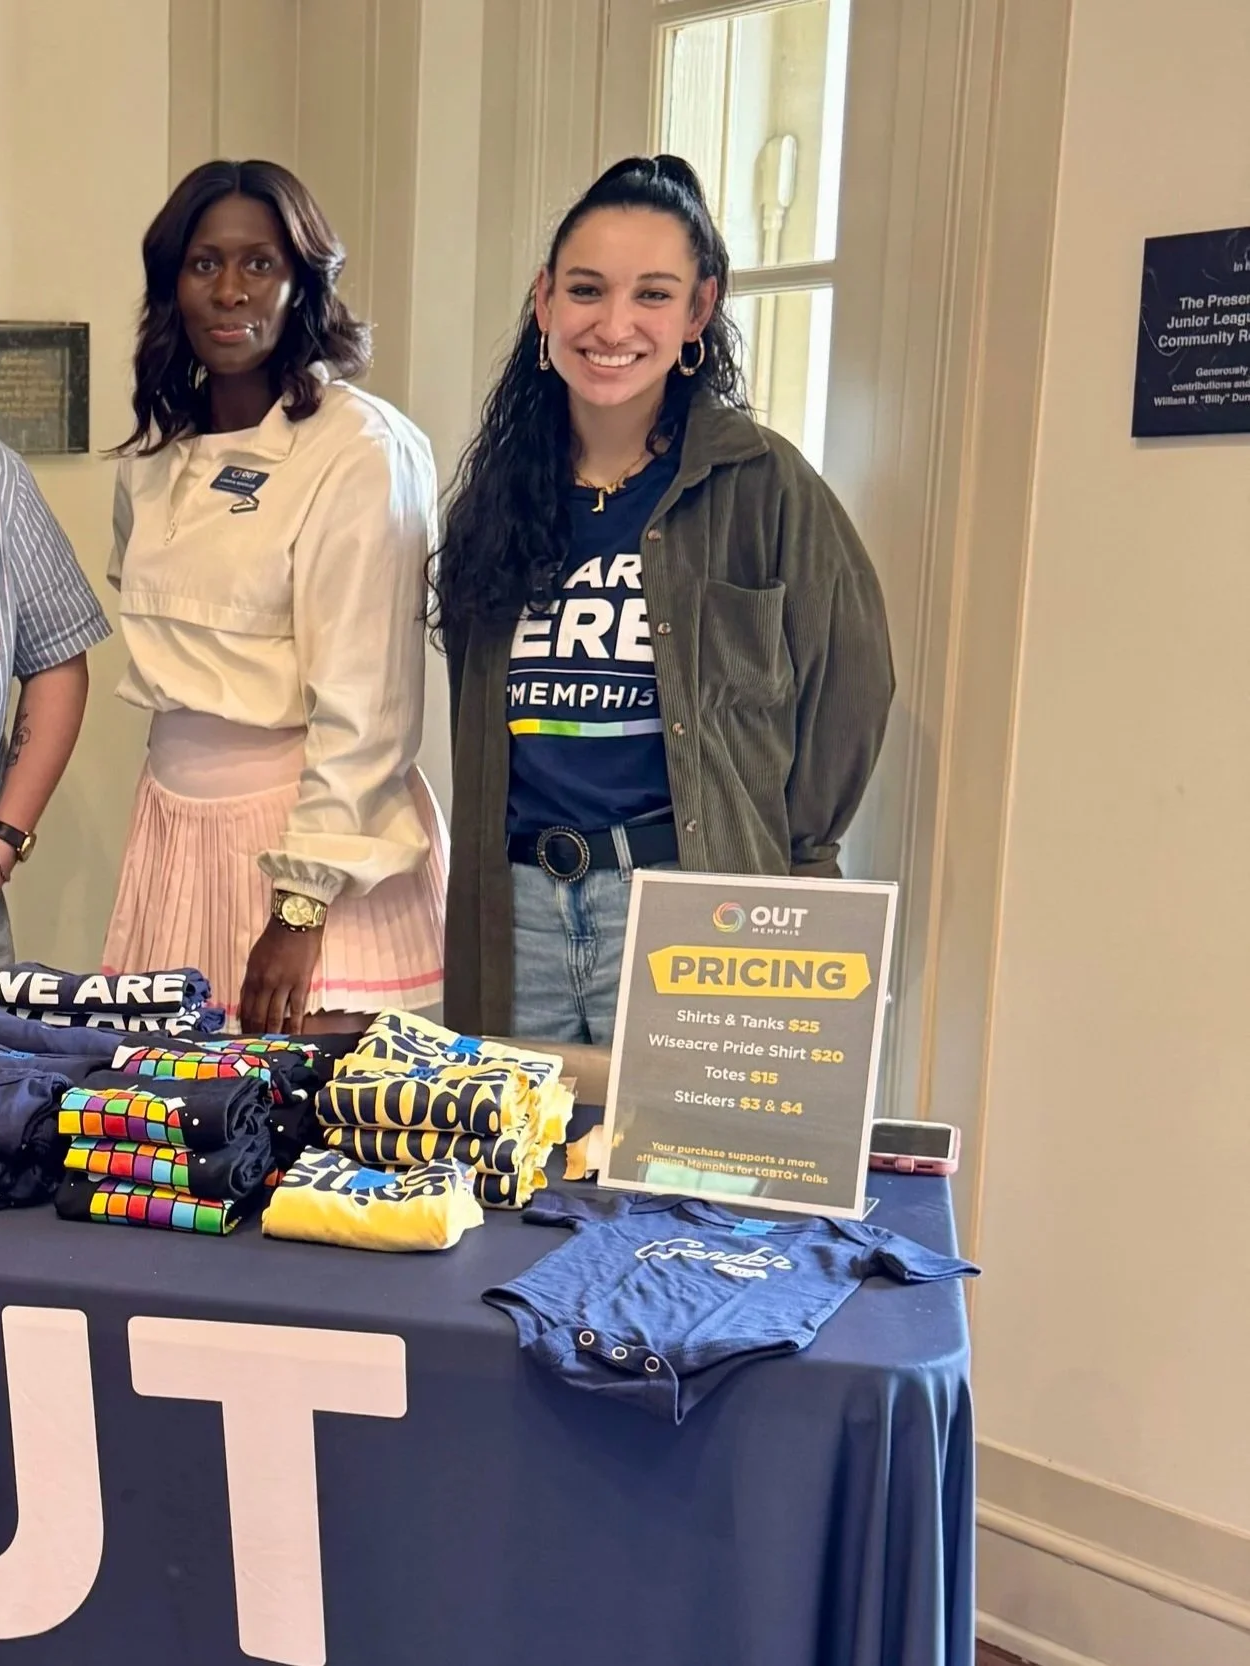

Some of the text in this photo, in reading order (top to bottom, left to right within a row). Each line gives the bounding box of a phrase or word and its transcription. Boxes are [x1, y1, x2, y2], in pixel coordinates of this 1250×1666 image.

[1180, 296, 1205, 311] The
[1166, 314, 1210, 330] Junior
[1157, 330, 1235, 349] Community
[1195, 365, 1248, 377] Generously
[1171, 380, 1232, 392] contributions
[1153, 395, 1187, 407] William
[562, 553, 643, 589] AR
[510, 598, 655, 662] ERE
[507, 682, 656, 708] MEMPHIS
[750, 906, 808, 929] OUT
[752, 927, 801, 936] MEMPHIS
[670, 955, 847, 991] PRICING
[72, 973, 188, 1005] ARE
[677, 1009, 821, 1034] Shirts & Tanks $25
[649, 1033, 845, 1064] Wiseacre Pride Shirt $20
[705, 1065, 779, 1085] Totes $15
[674, 1090, 804, 1116] Stickers $3 & $4
[652, 1141, 816, 1169] Your purchase supports a more
[636, 1153, 829, 1185] affirming Memphis for LGBTQ+ folks
[634, 1238, 793, 1270] Gender
